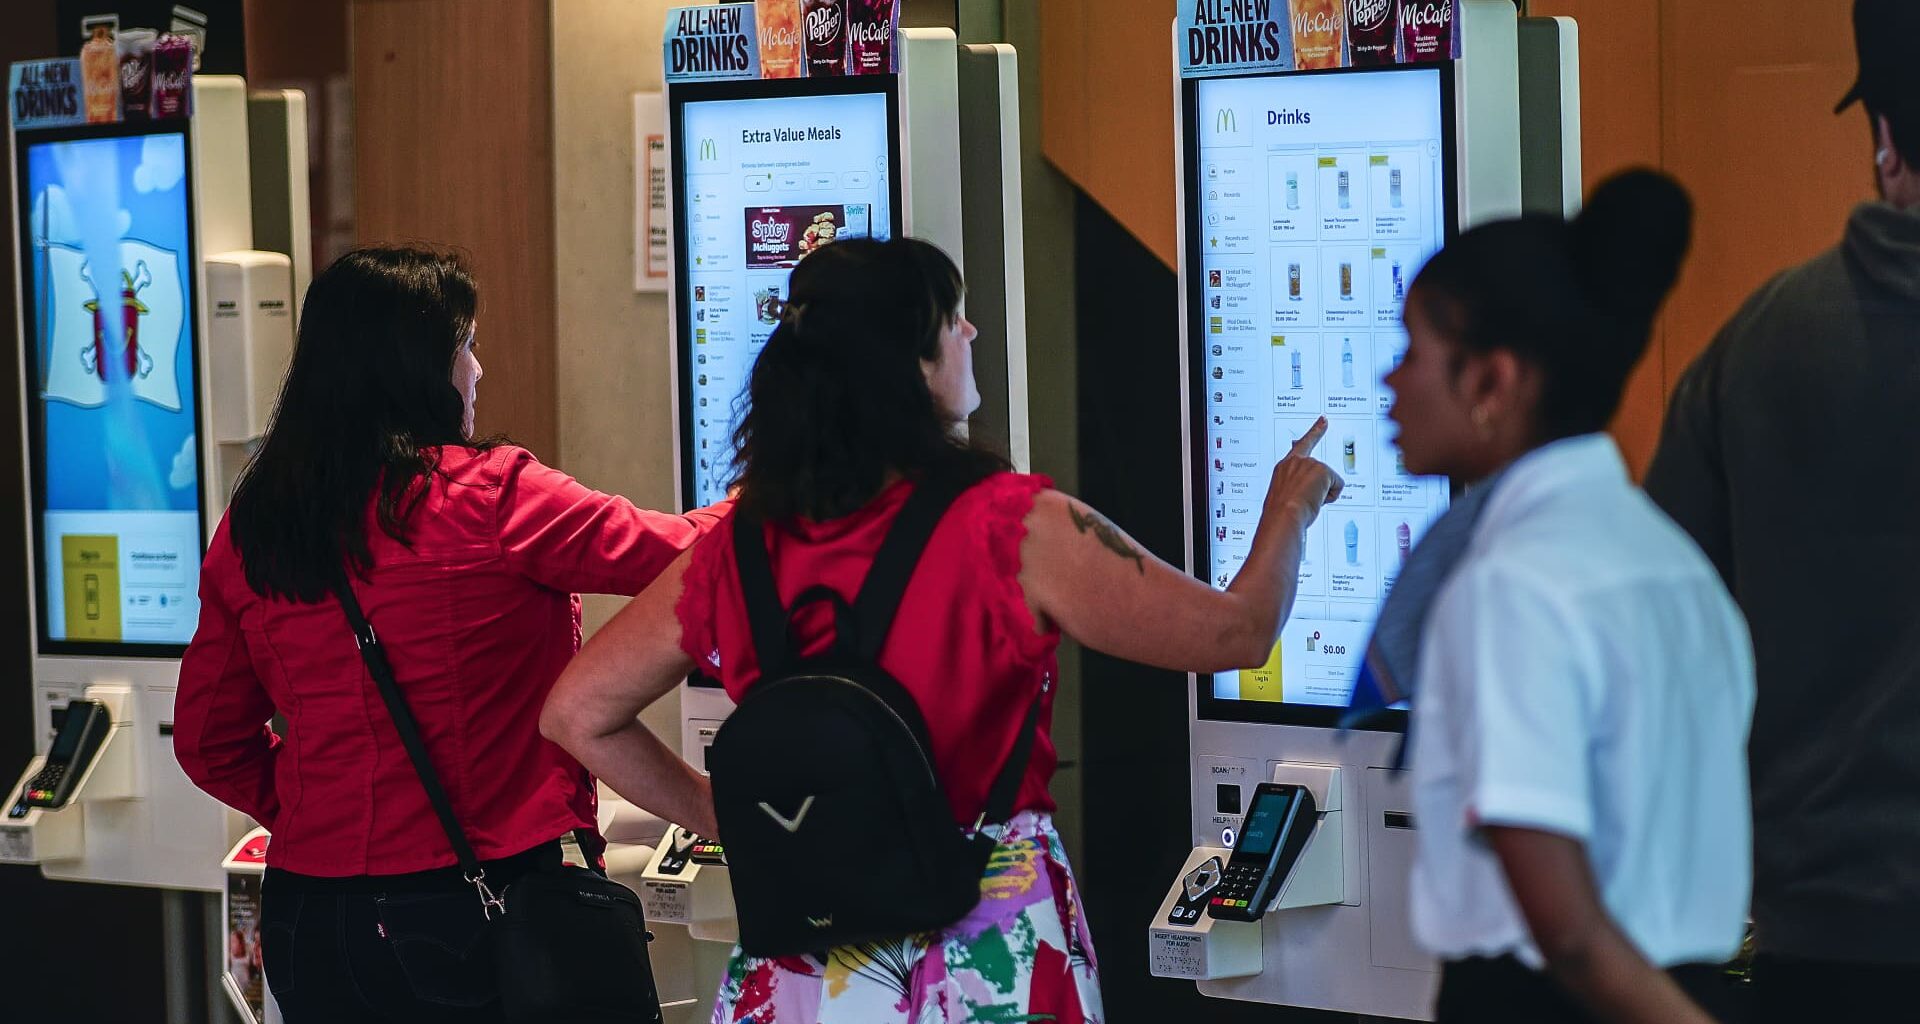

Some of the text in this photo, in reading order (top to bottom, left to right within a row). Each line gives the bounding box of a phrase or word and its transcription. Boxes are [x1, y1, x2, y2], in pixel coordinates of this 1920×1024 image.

[677, 8, 741, 36] ALL-NEW
[817, 8, 831, 24] Dr
[1195, 0, 1270, 25] ALL-NEW
[1294, 12, 1342, 37] McCafé
[1401, 0, 1451, 30] McCafé
[760, 27, 800, 50] McCafé
[809, 12, 839, 41] Pepper
[850, 20, 890, 46] McCafé
[672, 34, 749, 73] DRINKS
[1188, 21, 1280, 65] DRINKS
[15, 86, 78, 120] DRINKS
[1267, 109, 1311, 125] Drinks
[742, 126, 841, 144] Extra Value Meals
[846, 205, 864, 216] Sprite
[752, 217, 789, 242] Spicy
[752, 242, 790, 254] McNuggets
[1323, 645, 1346, 655] $0.00
